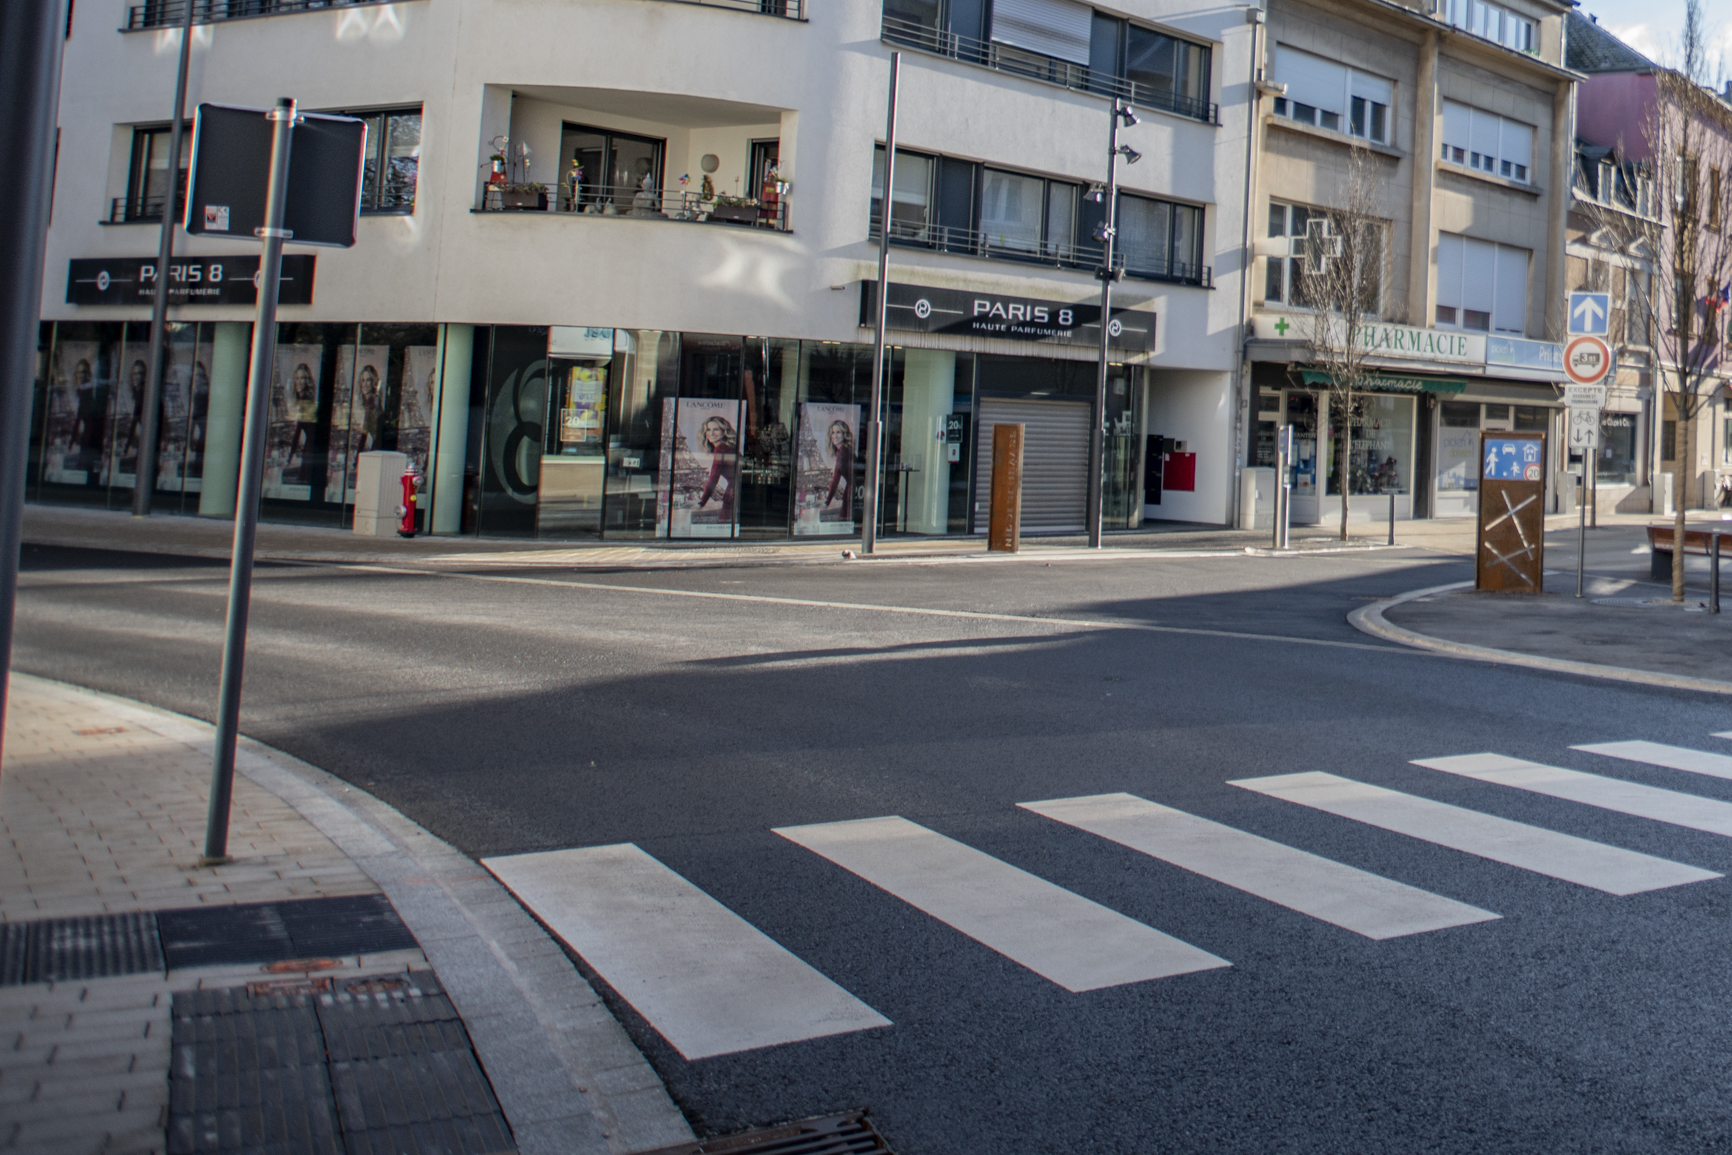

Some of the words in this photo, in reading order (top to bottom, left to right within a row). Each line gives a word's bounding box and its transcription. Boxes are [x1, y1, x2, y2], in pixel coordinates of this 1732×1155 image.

[208, 264, 224, 282] 8
[973, 299, 1049, 323] PARIS
[1058, 309, 1074, 326] 8
[972, 322, 1007, 332] HAUTE
[1011, 325, 1073, 338] PARFUMERIE
[1351, 325, 1468, 357] PHARMACIE
[1355, 371, 1424, 391] pharmacie
[1528, 468, 1539, 478] 20
